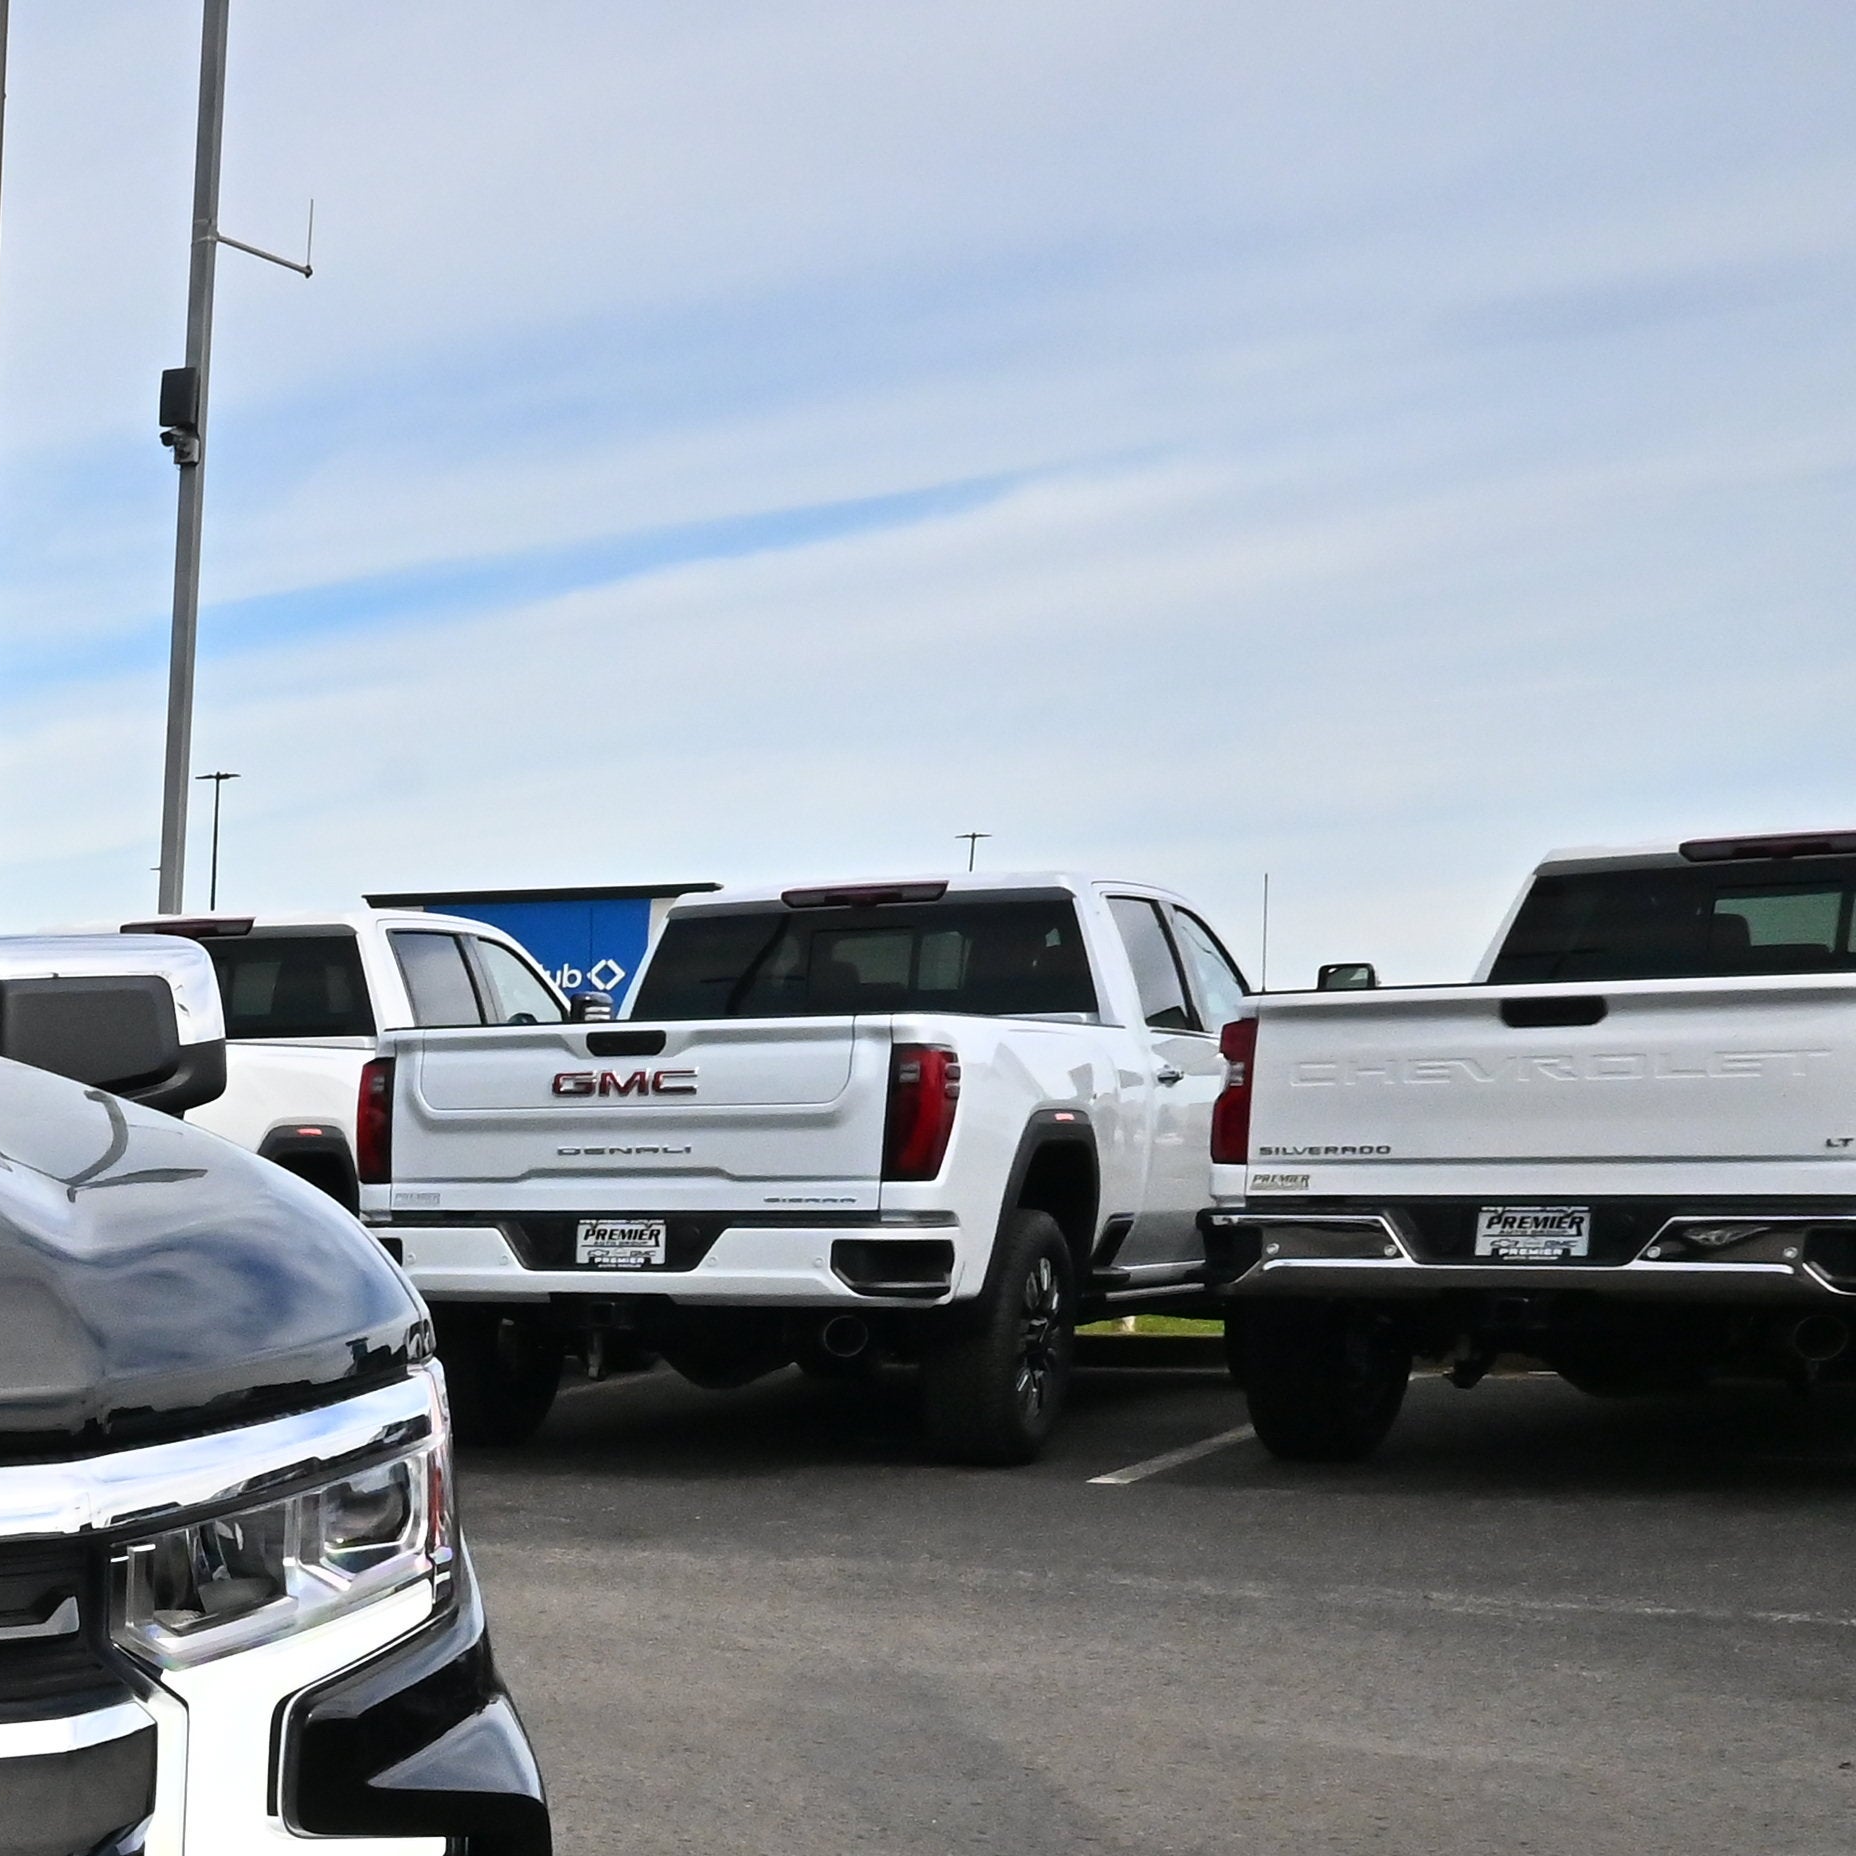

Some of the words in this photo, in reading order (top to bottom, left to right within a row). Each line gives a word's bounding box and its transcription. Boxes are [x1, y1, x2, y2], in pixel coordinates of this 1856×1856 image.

[1290, 1048, 1833, 1088] CHEVROLET
[552, 1066, 700, 1098] GMC
[557, 1144, 692, 1156] DENALI
[1258, 1145, 1391, 1156] SILVERADO
[1485, 1215, 1586, 1237] PREMIER
[583, 1228, 661, 1247] PREMIER
[1498, 1248, 1563, 1256] PREMIER
